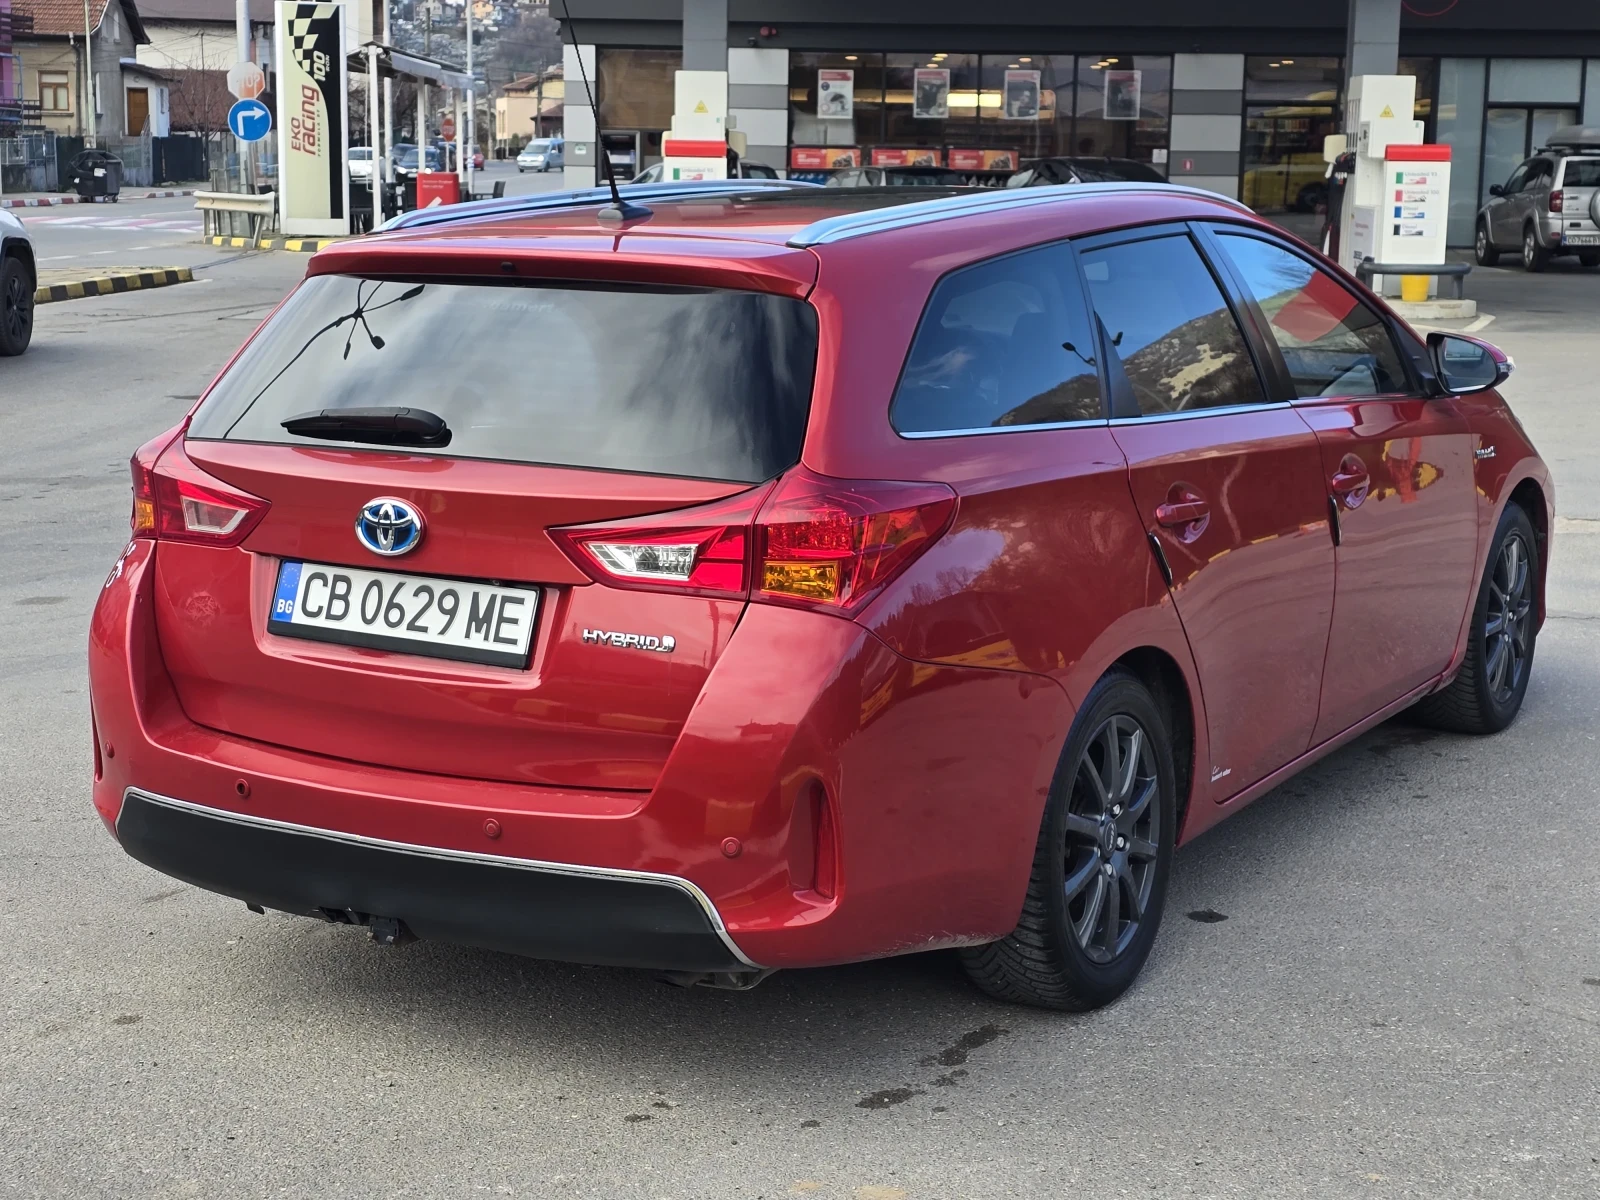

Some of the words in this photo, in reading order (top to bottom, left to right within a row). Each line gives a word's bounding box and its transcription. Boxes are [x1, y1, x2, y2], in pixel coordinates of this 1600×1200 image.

[313, 50, 326, 81] 100
[291, 117, 301, 151] EKO
[301, 84, 320, 156] racing
[276, 598, 294, 615] BG
[300, 571, 353, 621] CB
[360, 579, 461, 636] 0629
[464, 590, 526, 646] ME
[582, 628, 660, 650] HYBRID
